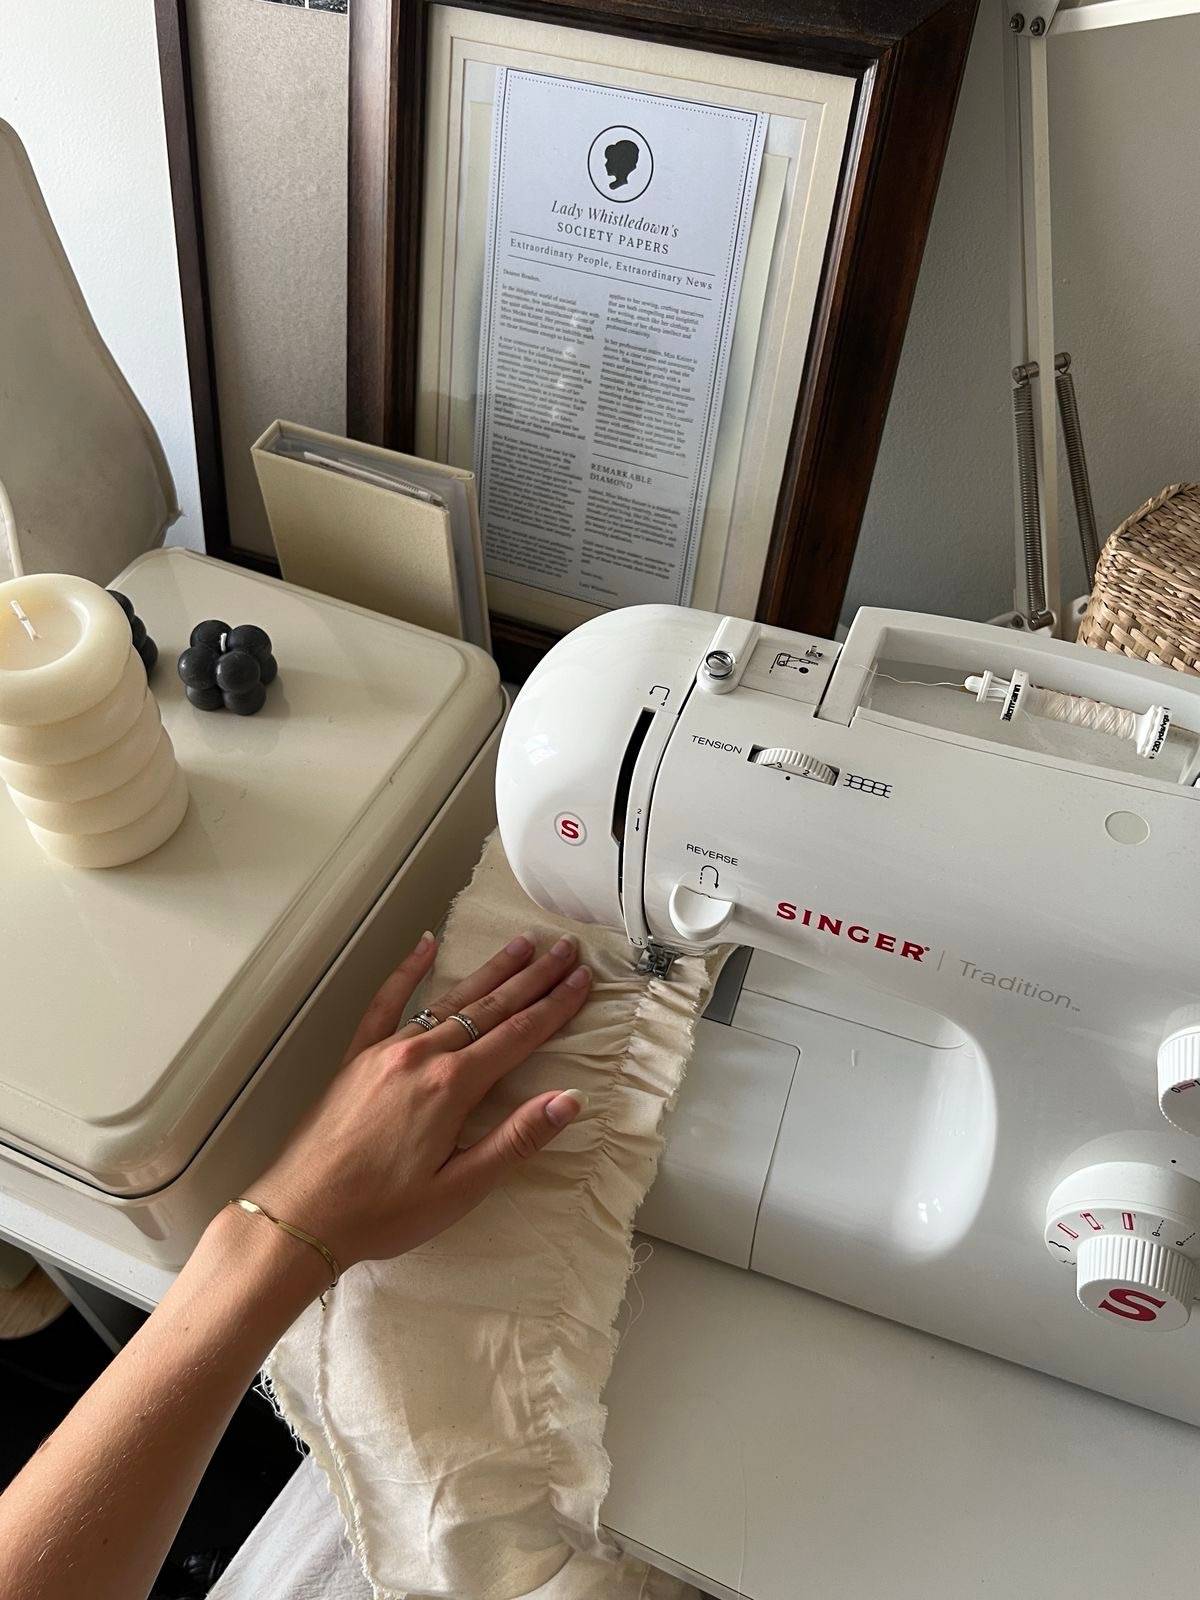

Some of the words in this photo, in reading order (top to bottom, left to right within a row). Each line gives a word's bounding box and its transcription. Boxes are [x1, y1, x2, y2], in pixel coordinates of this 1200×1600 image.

[551, 200, 583, 220] Lady
[588, 207, 679, 238] Whistledown's
[557, 222, 612, 244] SOCIETY
[619, 235, 669, 255] PAPERS
[510, 238, 574, 262] Extraordinary
[578, 253, 612, 270] People,
[616, 261, 682, 285] Extraordinary
[686, 277, 712, 290] News
[589, 473, 633, 490] DIAMOND
[591, 463, 653, 485] REMARKABLE
[691, 735, 743, 755] TENSION
[561, 819, 579, 840] S
[686, 843, 739, 866] REVERSE
[776, 902, 925, 963] SINGER
[959, 958, 1072, 1010] Tradition
